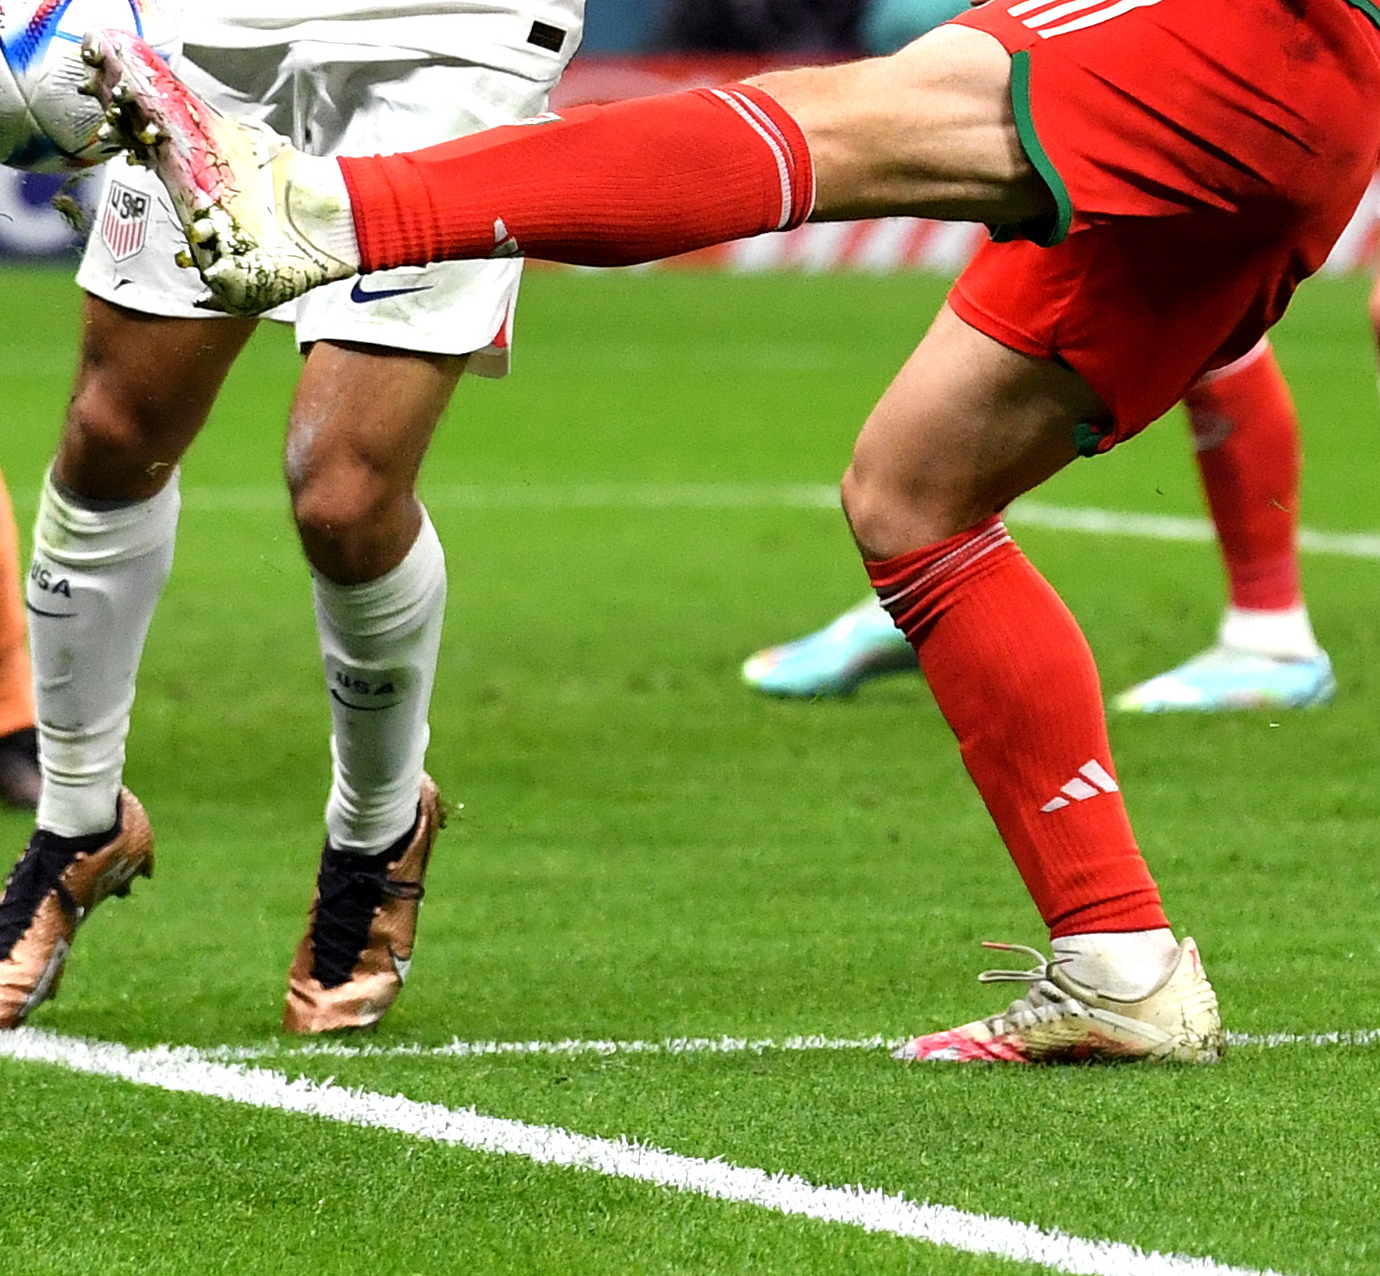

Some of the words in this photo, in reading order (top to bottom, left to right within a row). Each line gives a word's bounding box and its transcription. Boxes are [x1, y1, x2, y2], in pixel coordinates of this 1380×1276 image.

[111, 186, 146, 220] USA
[31, 560, 72, 599] USA
[336, 671, 394, 696] USA
